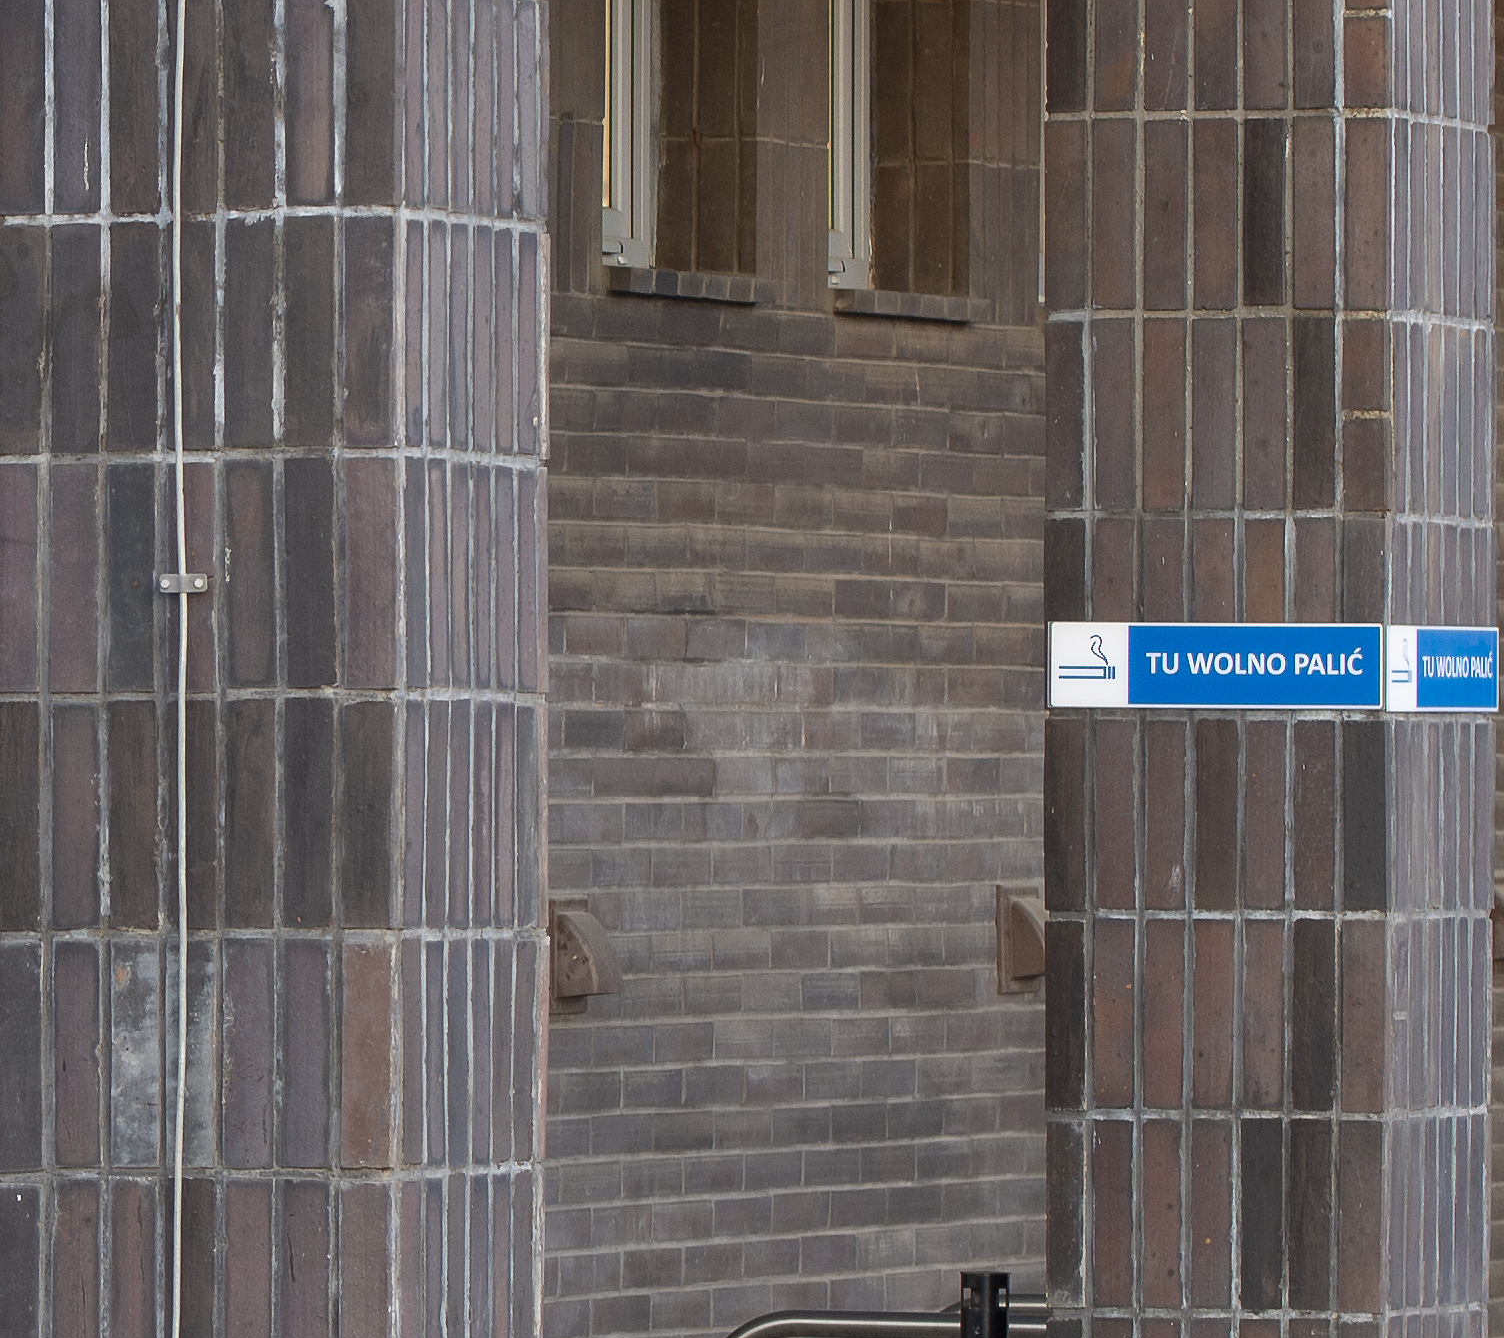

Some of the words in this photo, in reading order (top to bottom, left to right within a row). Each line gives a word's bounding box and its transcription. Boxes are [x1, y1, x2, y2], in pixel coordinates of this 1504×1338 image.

[1145, 652, 1180, 675] TU
[1187, 652, 1286, 676] WOLNO
[1294, 647, 1364, 676] PALIĆ
[1422, 656, 1435, 678] TU
[1436, 656, 1470, 679] WOLNO
[1471, 651, 1494, 679] PALIĆ
